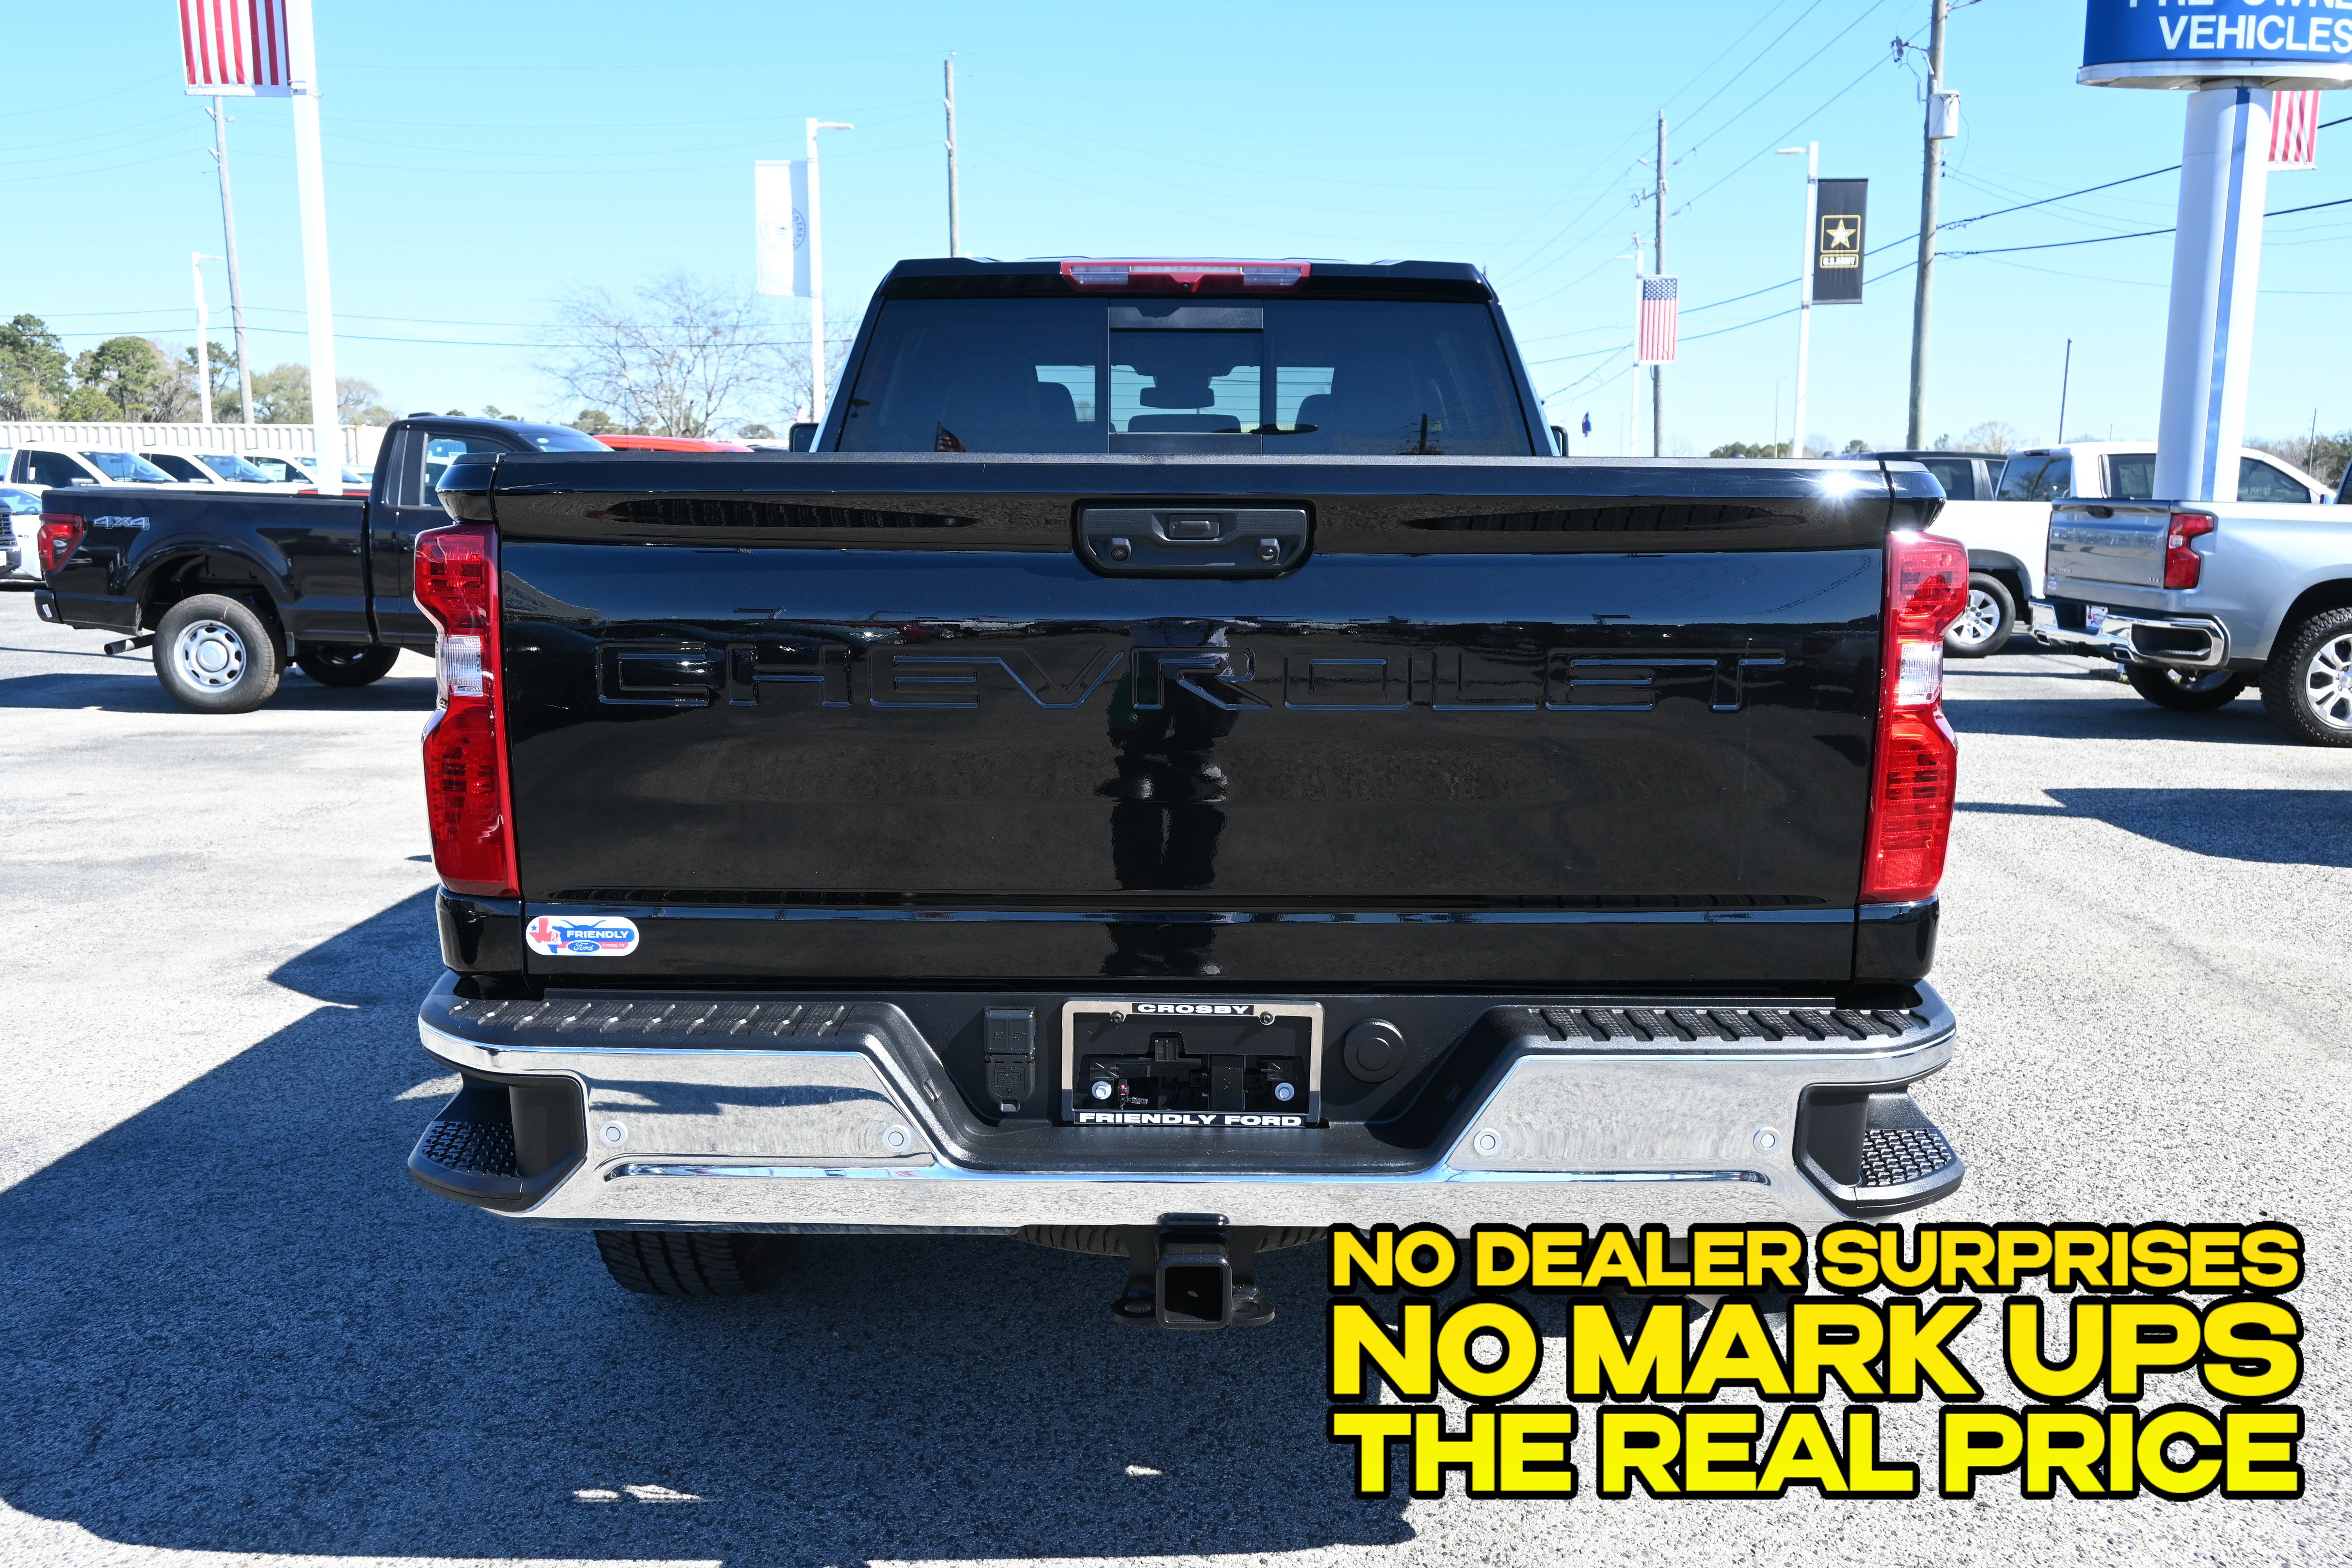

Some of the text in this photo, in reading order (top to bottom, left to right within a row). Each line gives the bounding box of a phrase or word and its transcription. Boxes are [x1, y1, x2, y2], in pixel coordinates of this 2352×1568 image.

[2158, 15, 2352, 54] VEHICLES
[595, 640, 1788, 710] CHEVROLET
[566, 930, 629, 939] FRIENDLY
[573, 942, 594, 951] Ford
[1137, 1004, 1249, 1014] CROSBY
[1079, 1112, 1302, 1127] FRIENDLY FORD
